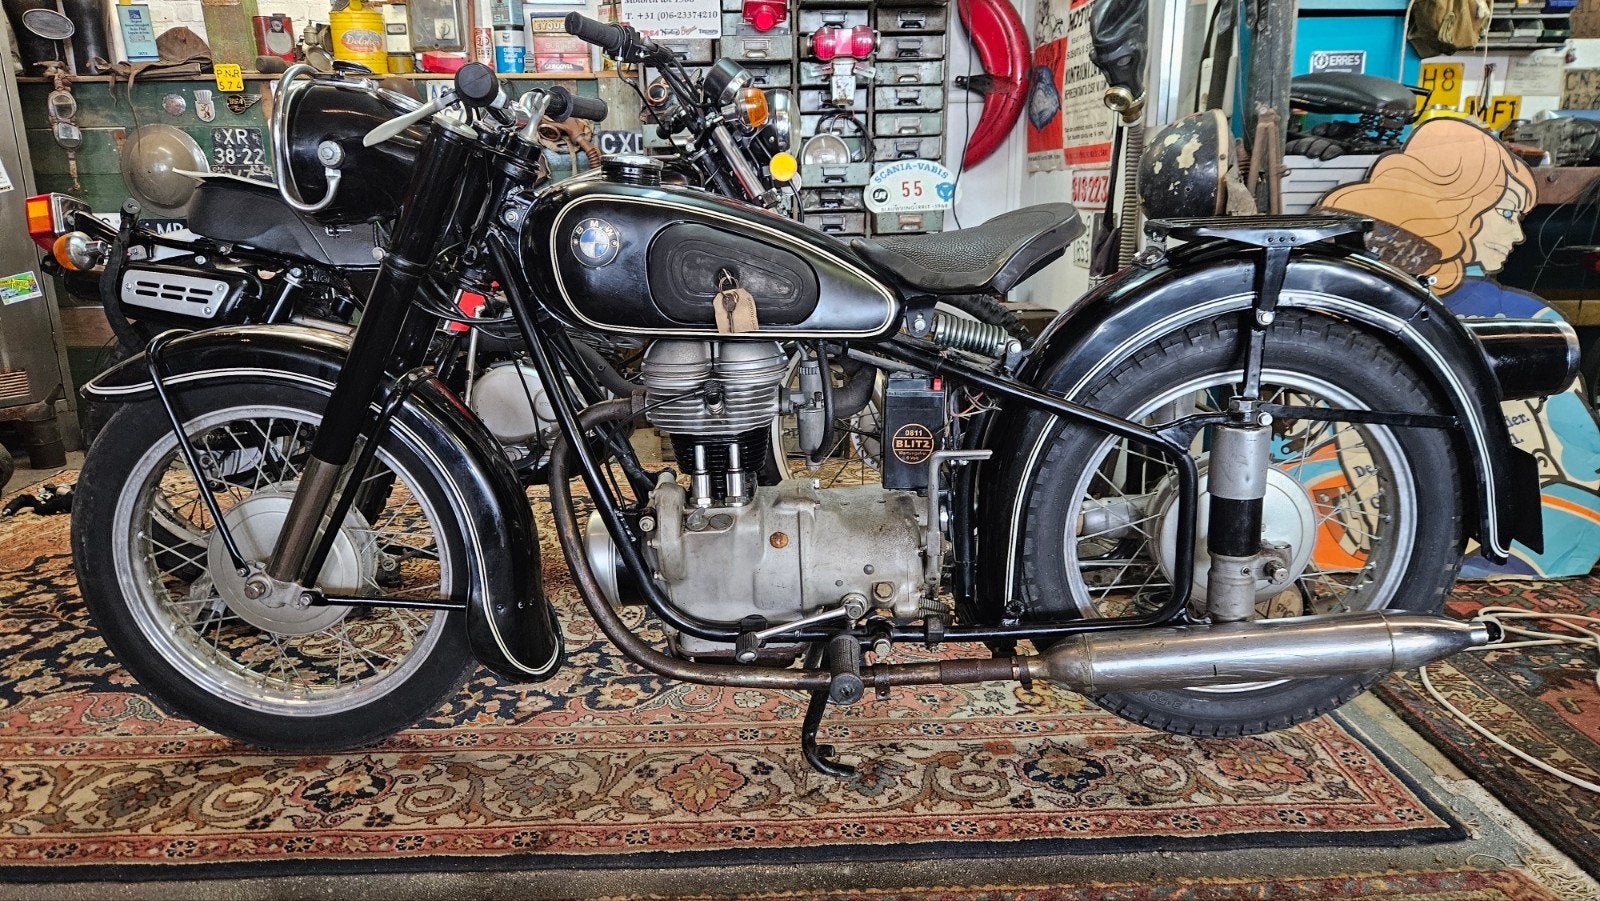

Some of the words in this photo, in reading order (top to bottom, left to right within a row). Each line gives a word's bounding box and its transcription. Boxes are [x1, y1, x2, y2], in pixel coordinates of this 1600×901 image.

[637, 12, 655, 20] +31
[1329, 54, 1361, 66] ERRES
[1422, 67, 1455, 91] H8
[221, 128, 249, 145] XR
[214, 148, 265, 165] 38-22
[875, 162, 949, 184] SCANIA-VABIS
[901, 180, 923, 198] 55
[575, 220, 615, 237] BMW
[904, 429, 923, 437] 0811
[895, 439, 931, 449] BLITZ
